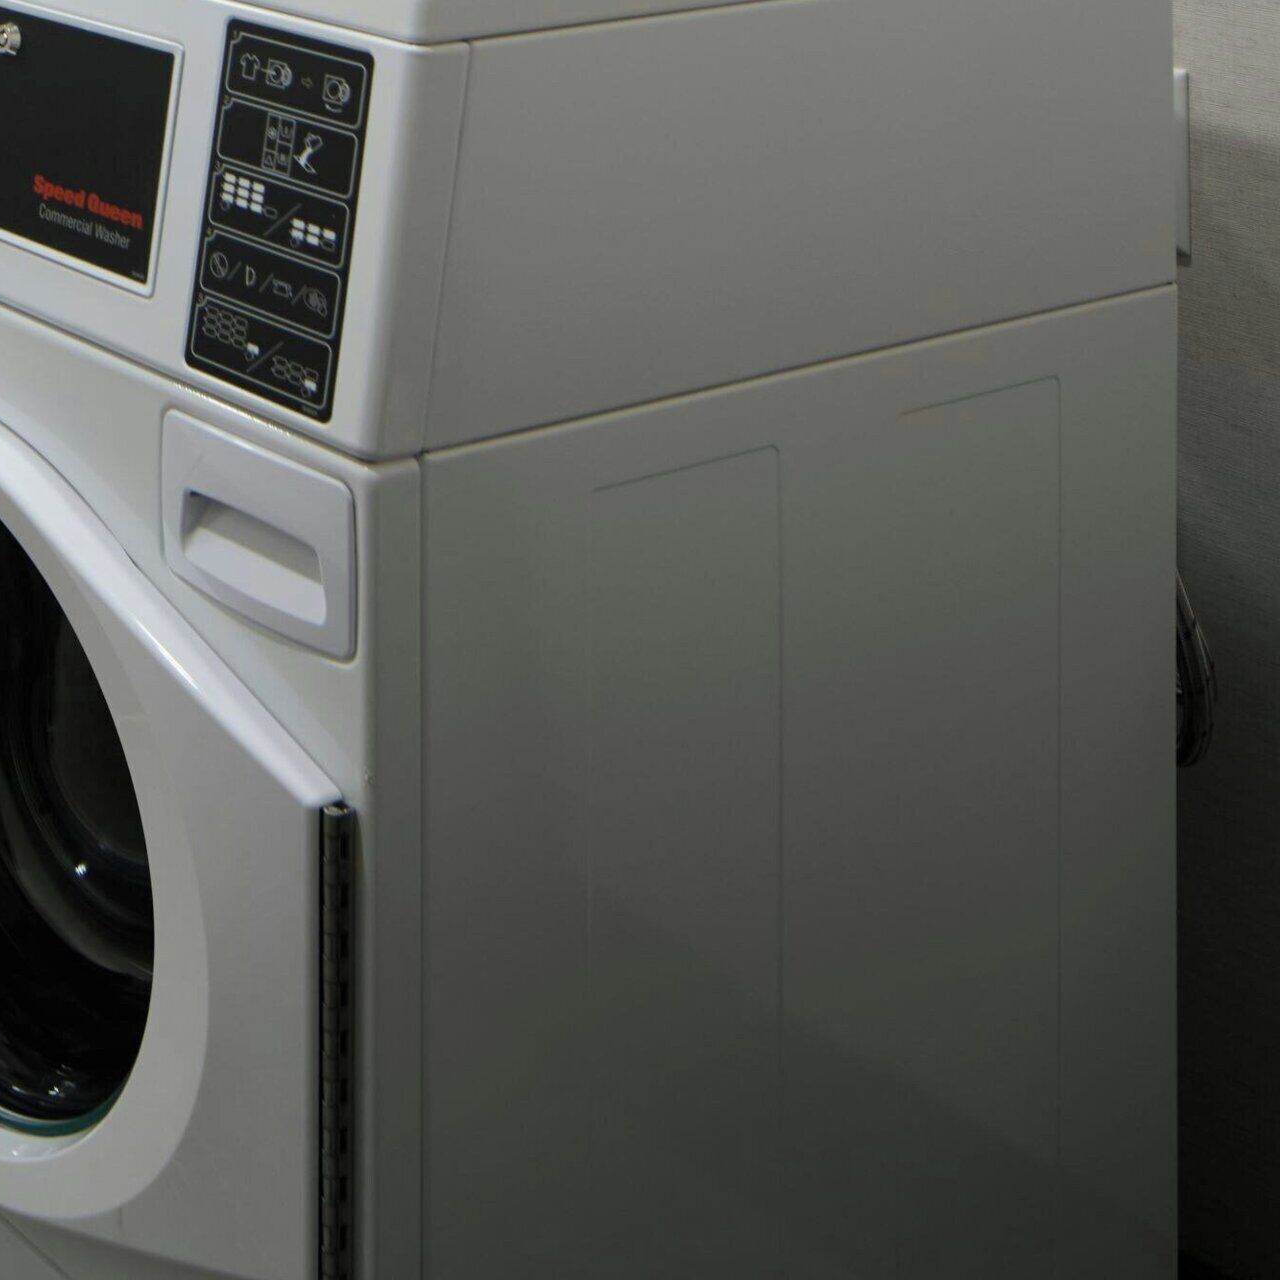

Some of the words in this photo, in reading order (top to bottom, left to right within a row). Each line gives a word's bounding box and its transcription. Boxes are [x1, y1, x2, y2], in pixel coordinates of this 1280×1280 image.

[33, 174, 86, 209] Speed
[88, 193, 143, 230] Queen
[39, 202, 93, 236] Commercial
[95, 222, 130, 250] Washer
